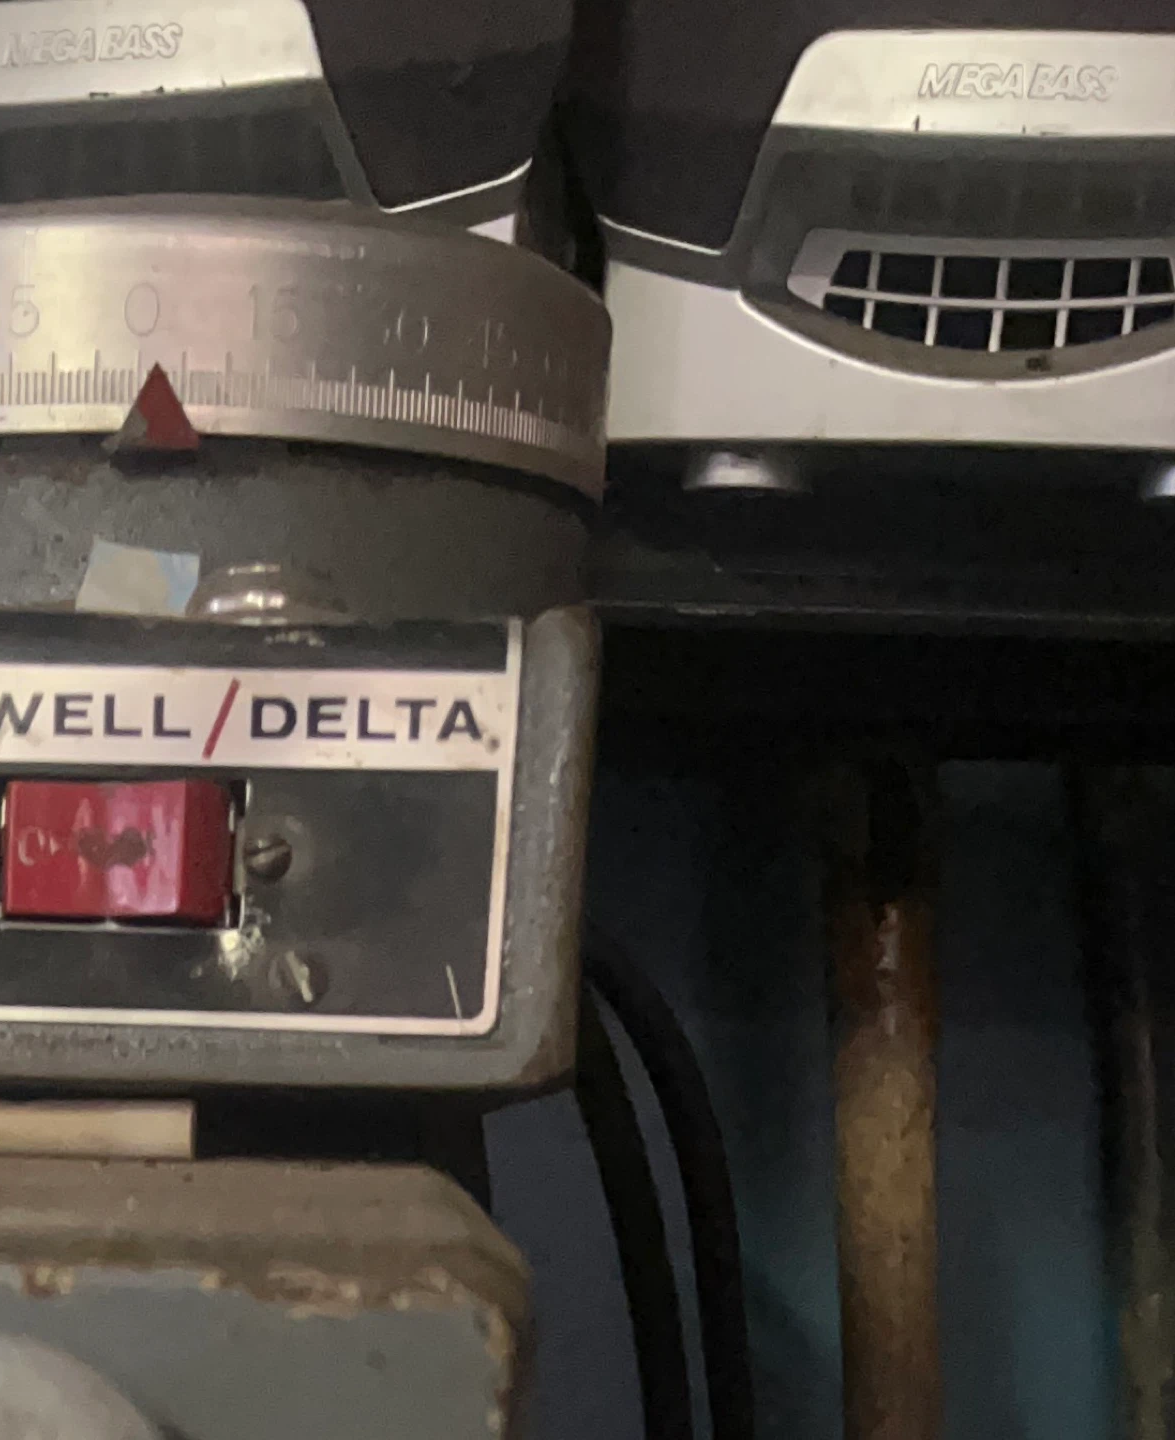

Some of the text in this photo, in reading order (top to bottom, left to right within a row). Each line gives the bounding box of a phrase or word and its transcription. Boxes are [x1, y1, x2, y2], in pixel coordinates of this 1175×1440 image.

[0, 22, 183, 68] MEGA BASS
[917, 62, 1119, 102] MEGA BASS
[124, 282, 161, 337] 0
